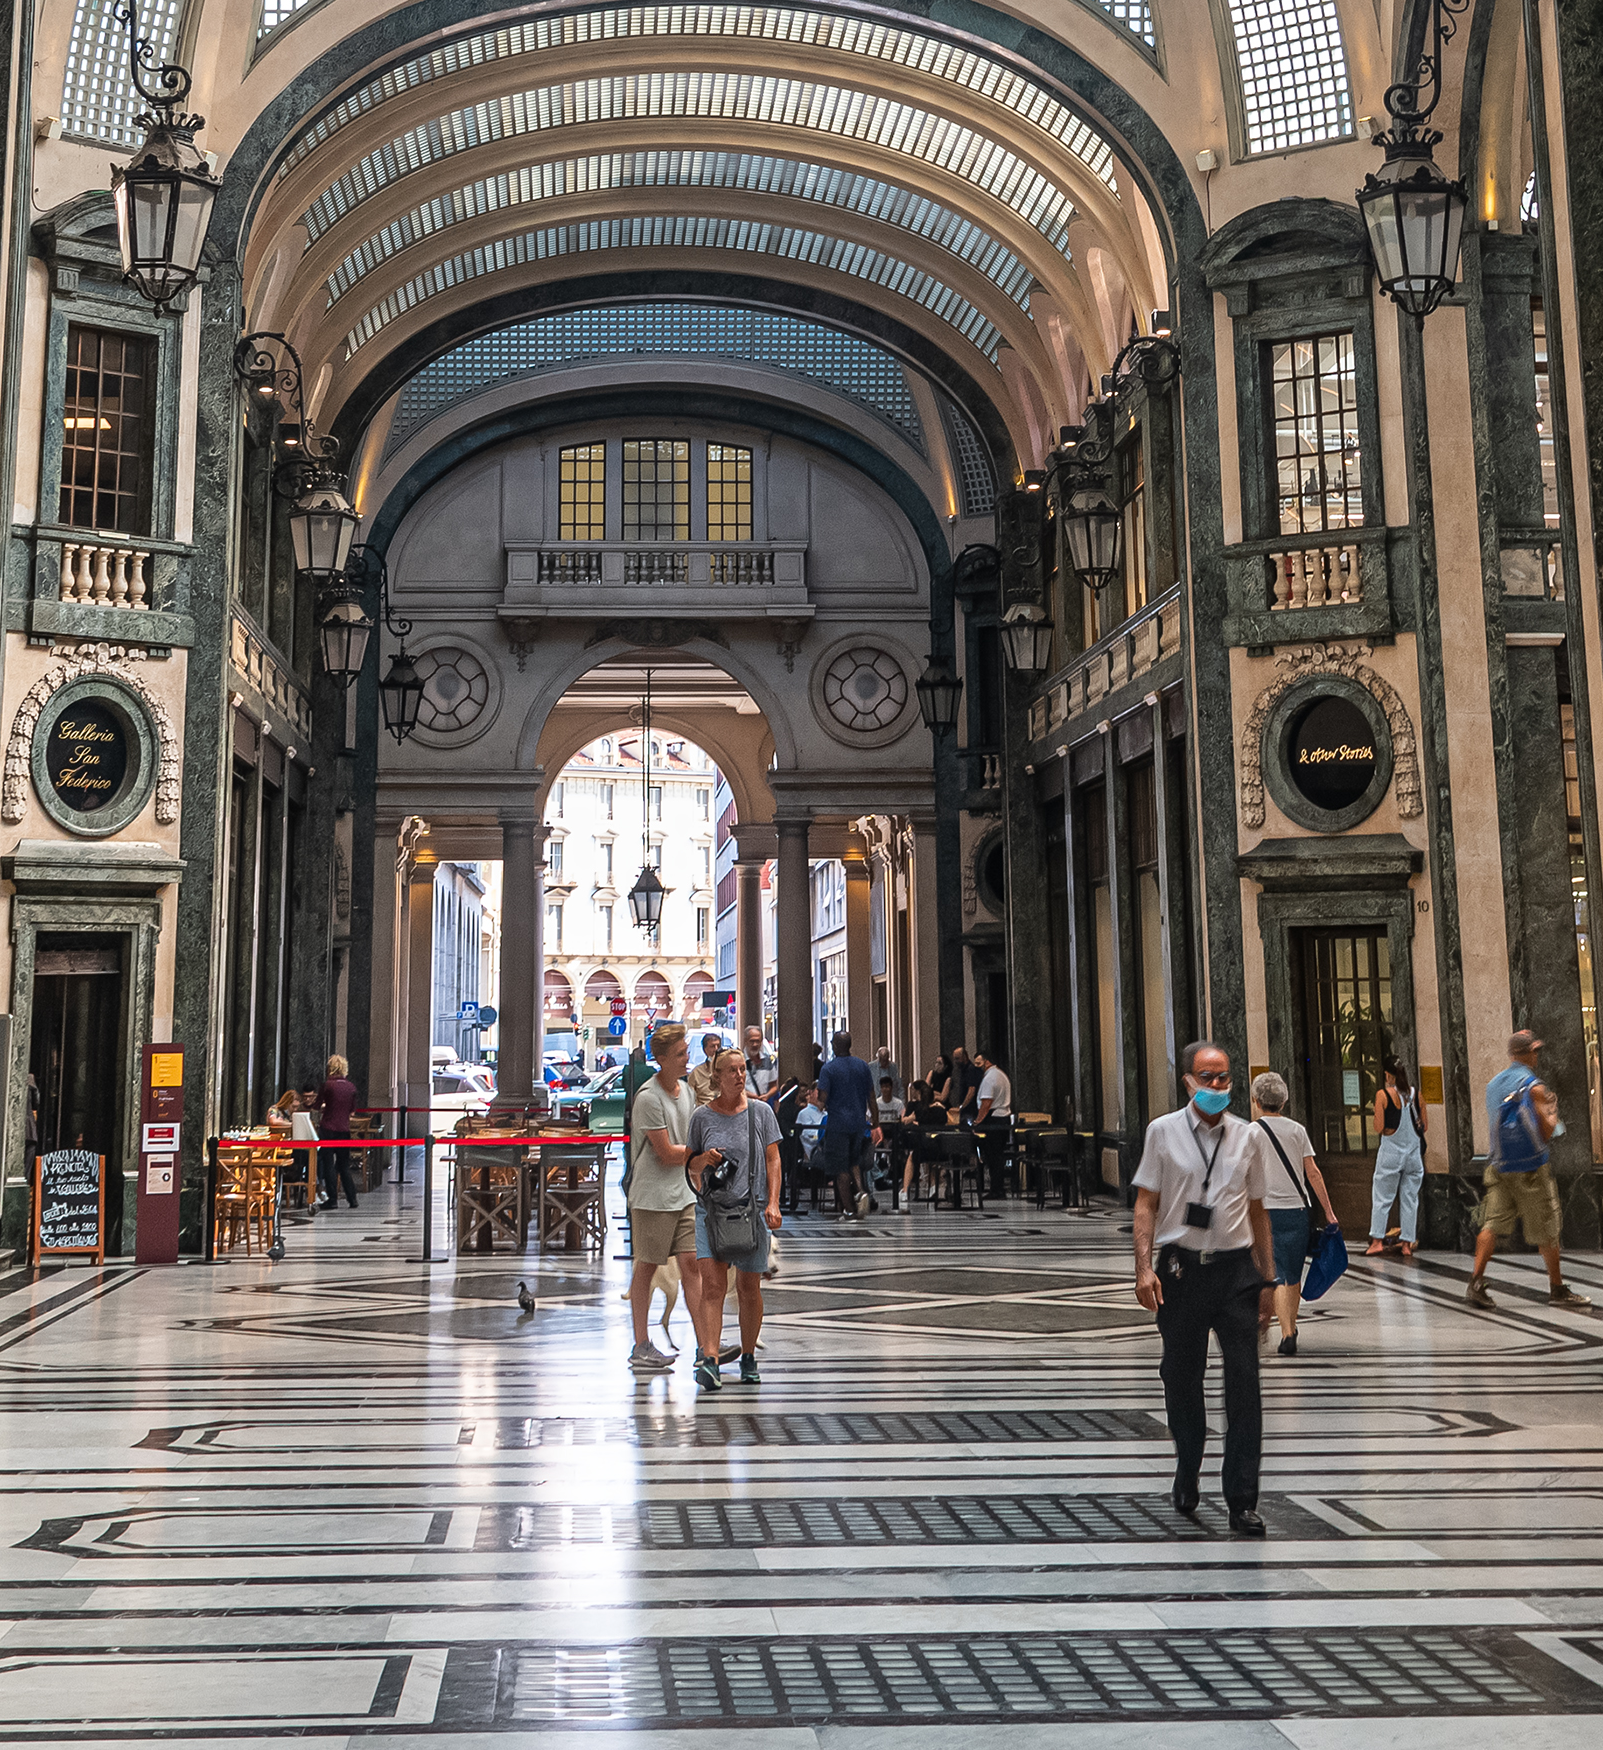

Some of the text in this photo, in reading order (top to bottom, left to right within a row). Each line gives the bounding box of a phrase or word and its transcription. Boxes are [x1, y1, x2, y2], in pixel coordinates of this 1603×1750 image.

[58, 720, 115, 742] Galleria
[69, 745, 100, 765] San
[1299, 744, 1373, 764] & other Stories
[55, 767, 112, 790] Federico
[1417, 900, 1430, 913] 10
[611, 1002, 626, 1010] STOP
